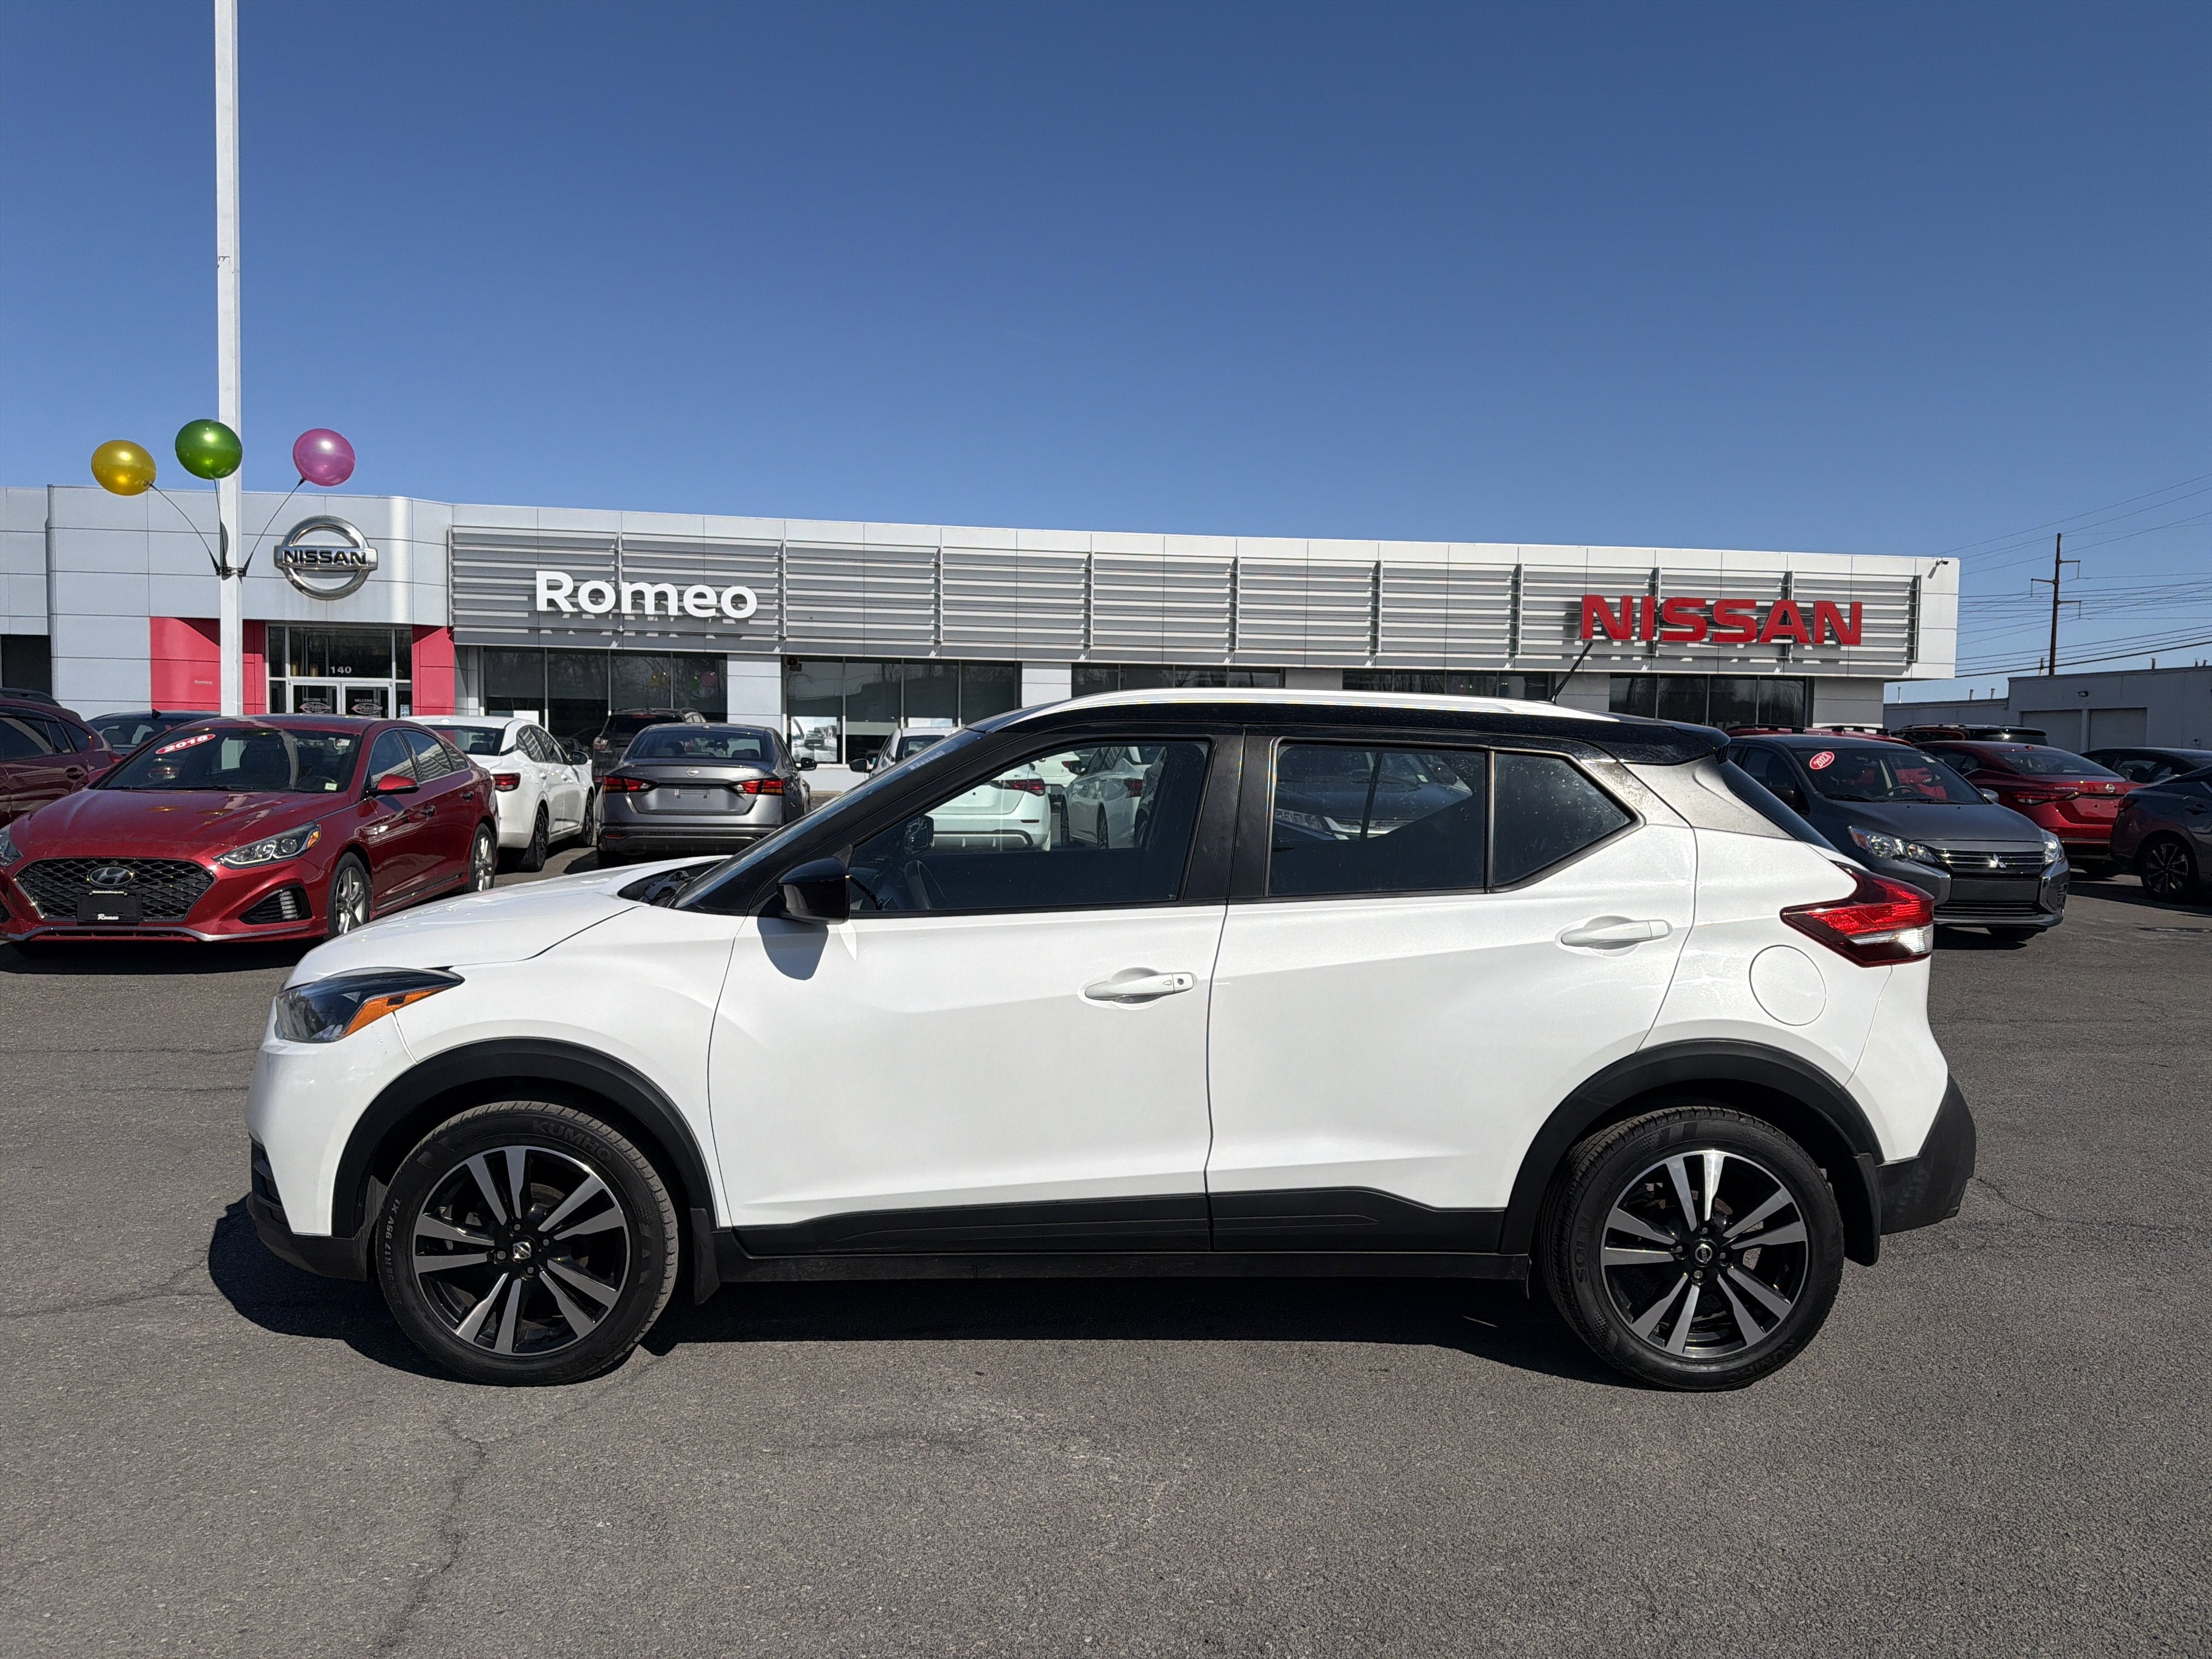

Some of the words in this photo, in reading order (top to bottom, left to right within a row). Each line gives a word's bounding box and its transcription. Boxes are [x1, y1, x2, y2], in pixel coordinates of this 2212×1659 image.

[283, 550, 366, 565] NISSAN
[536, 570, 758, 618] Romeo
[1581, 594, 1863, 645] NISSAN
[330, 666, 352, 674] 140
[1813, 753, 1831, 768] 2023
[532, 1120, 612, 1161] KUMHO
[385, 1216, 394, 1239] 95V
